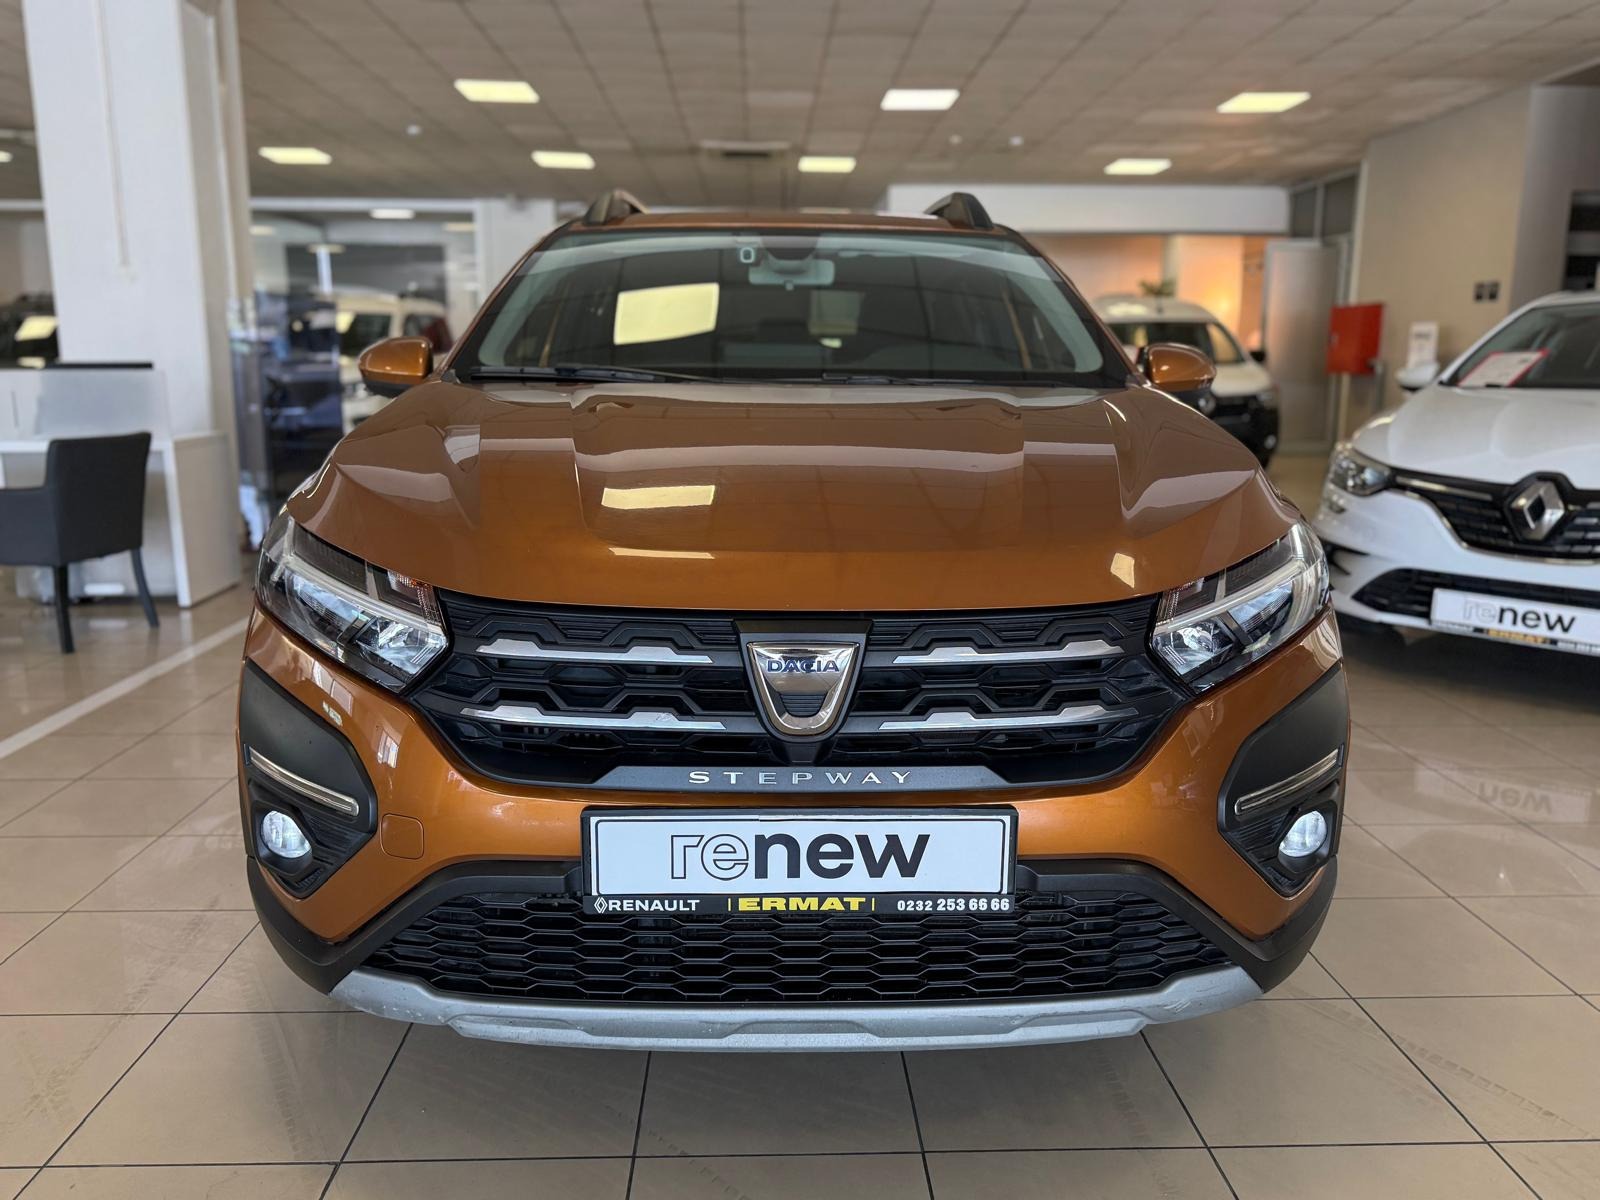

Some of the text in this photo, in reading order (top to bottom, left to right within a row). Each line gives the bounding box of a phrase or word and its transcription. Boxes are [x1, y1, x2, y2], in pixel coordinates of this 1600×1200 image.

[767, 658, 840, 674] DACIA
[688, 771, 911, 785] STEPWAY
[670, 831, 931, 881] renew
[608, 897, 1010, 911] RENAULT ERMAT 0232 253 66 66
